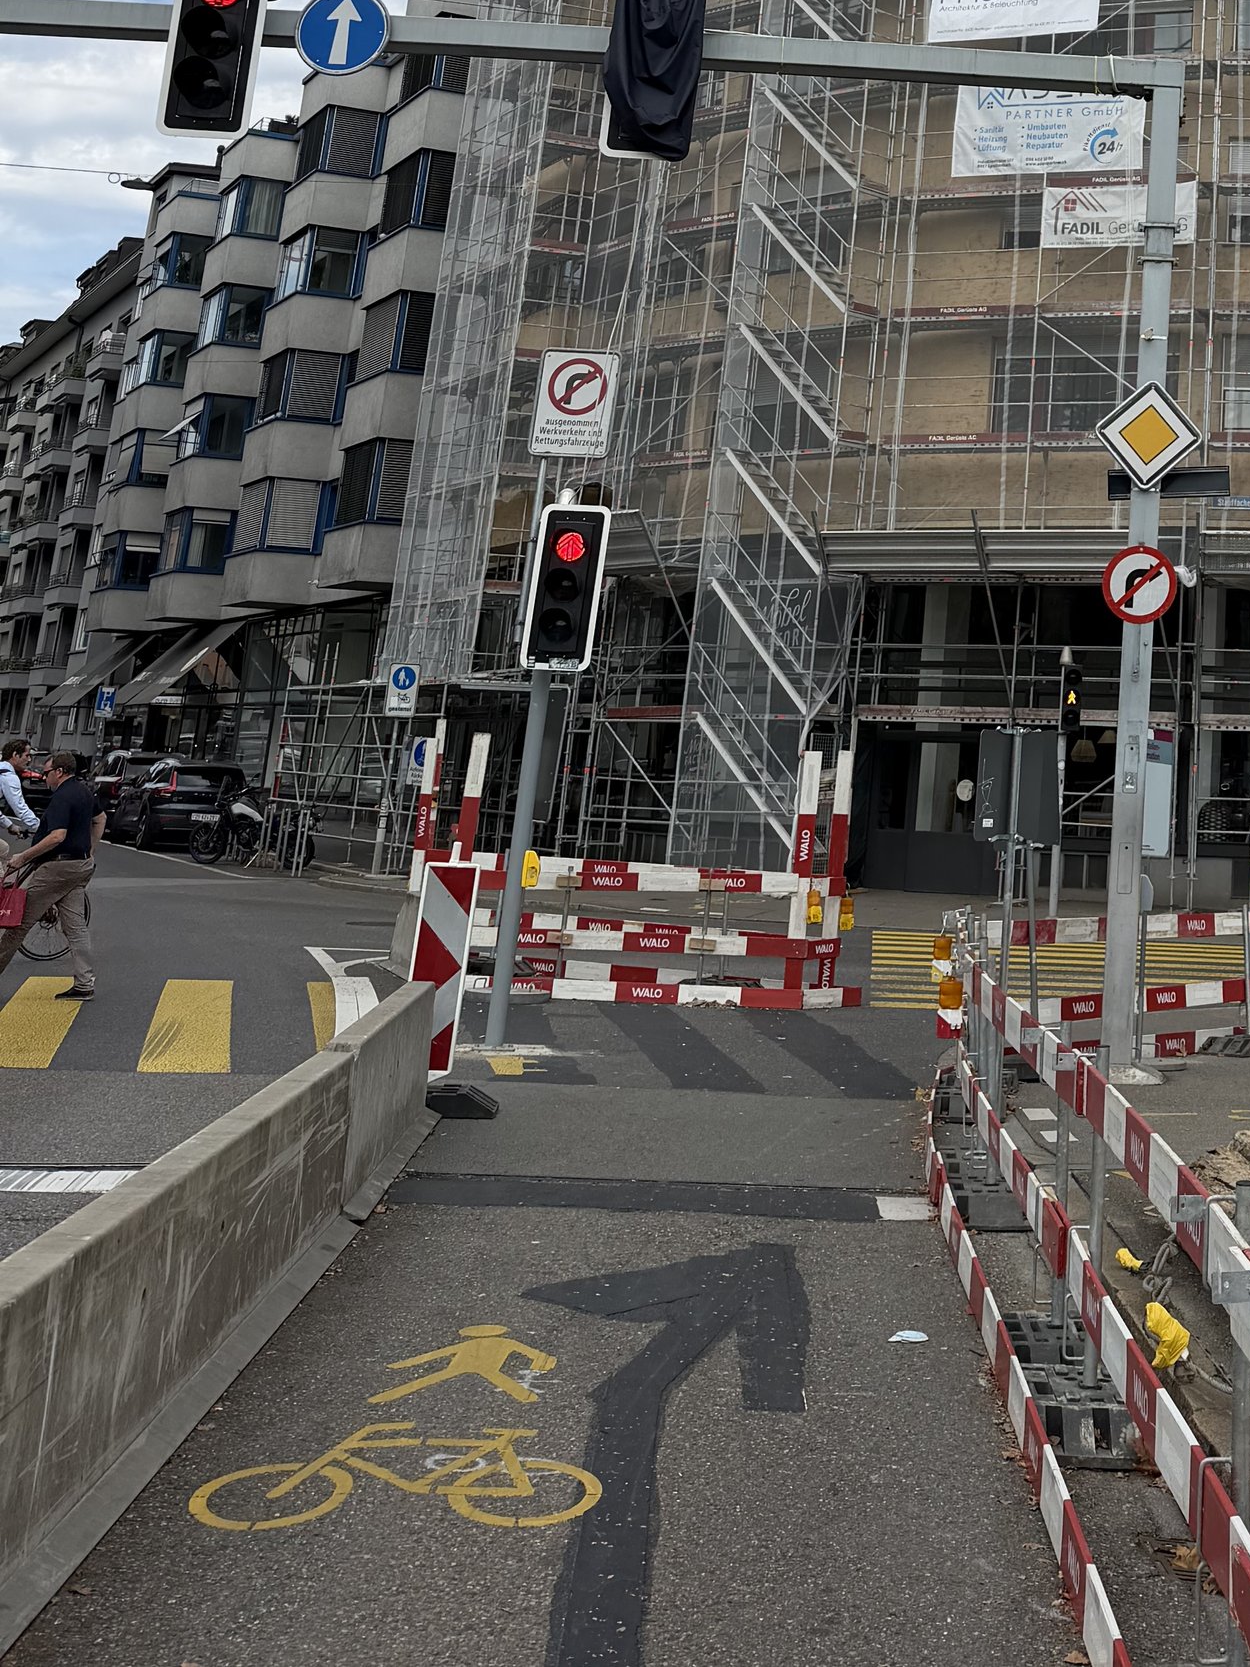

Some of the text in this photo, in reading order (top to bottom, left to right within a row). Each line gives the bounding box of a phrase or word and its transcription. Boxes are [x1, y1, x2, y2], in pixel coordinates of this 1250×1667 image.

[939, 4, 981, 12] Architektur
[1005, 106, 1123, 120] PARTNER GmbH
[979, 126, 1004, 134] Sanitär
[1027, 123, 1067, 131] Umbauten
[978, 135, 1008, 144] Heizung
[1026, 132, 1068, 140] Neubauten
[977, 144, 1006, 153] Lüftung
[1025, 141, 1063, 151] Reparatur
[1061, 221, 1104, 235] FADIL
[1177, 217, 1188, 232] G
[545, 418, 599, 428] ausgenommen
[539, 426, 586, 437] Werkverkehr
[534, 436, 604, 448] Rettungsfahrzeuge
[418, 806, 427, 838] WALO
[799, 829, 811, 861] WALO
[594, 865, 617, 873] WALO
[592, 877, 623, 886] WALO
[588, 922, 611, 931] WALO
[1186, 919, 1206, 931] WALO
[639, 938, 670, 948] WALO
[815, 943, 834, 955] WALO
[533, 961, 555, 972] WALO
[822, 958, 831, 990] WALO
[632, 987, 663, 998] WALO
[1156, 991, 1176, 1004] WALO
[1072, 1000, 1095, 1014] WALO
[1165, 1038, 1186, 1051] WALO
[1130, 1129, 1145, 1173] WALO
[1133, 1369, 1149, 1422] WALO
